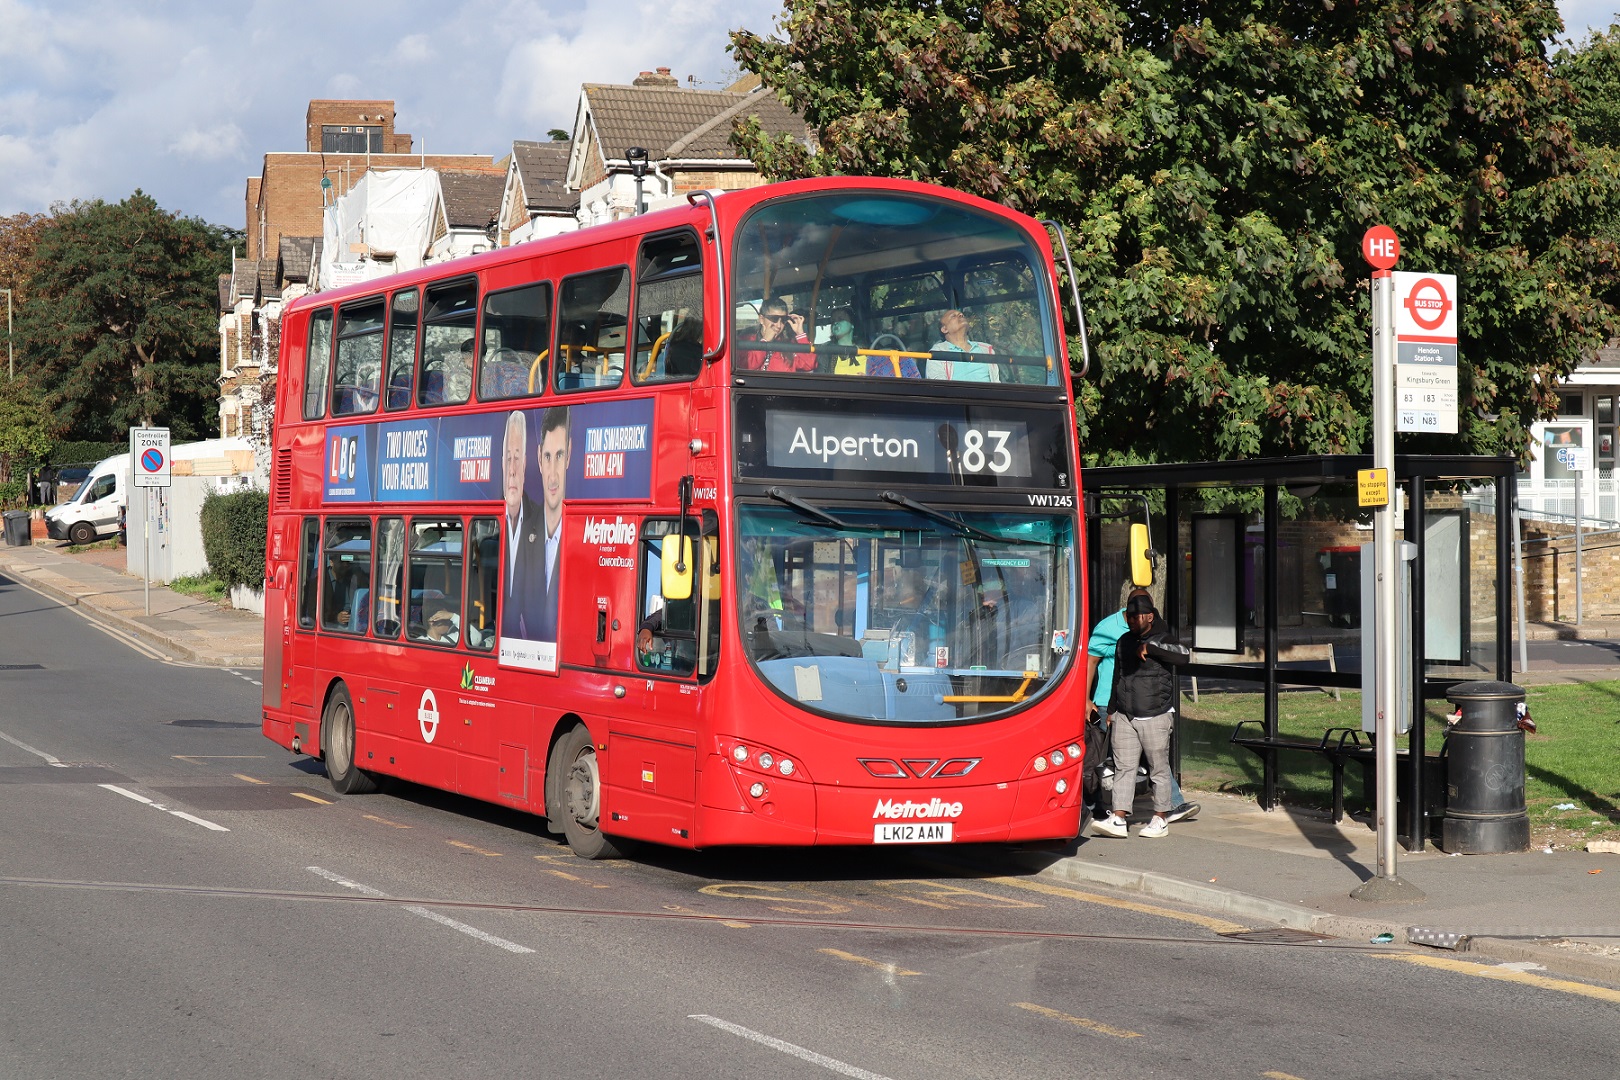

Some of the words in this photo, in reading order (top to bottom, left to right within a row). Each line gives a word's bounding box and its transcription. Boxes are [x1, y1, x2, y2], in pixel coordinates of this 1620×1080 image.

[1370, 238, 1395, 257] HE
[1427, 300, 1444, 308] STOP
[1407, 376, 1434, 385] Kingsbury
[1404, 394, 1413, 402] 83
[1423, 394, 1436, 403] 183
[1403, 416, 1414, 425] N5
[1422, 417, 1437, 425] N83
[386, 431, 401, 458] TWO
[402, 429, 428, 458] VOICES
[467, 436, 492, 458] FERRARI
[588, 429, 603, 452] TOM
[603, 425, 646, 451] SWARBRICK
[789, 426, 919, 463] Alperton
[331, 437, 356, 479] LBC
[962, 429, 1011, 473] 83
[460, 460, 476, 480] FROM
[476, 459, 490, 480] 7AM
[586, 454, 606, 476] FROM
[606, 453, 623, 476] 4PM
[381, 463, 399, 490] YOUR
[399, 462, 429, 490] AGENDA
[694, 487, 717, 500] VW1245
[1027, 494, 1073, 507] VW1245
[583, 515, 636, 545] Metroline
[646, 680, 655, 691] PV
[872, 797, 963, 819] Metroline
[883, 826, 914, 840] LK12
[918, 825, 944, 839] AAN
